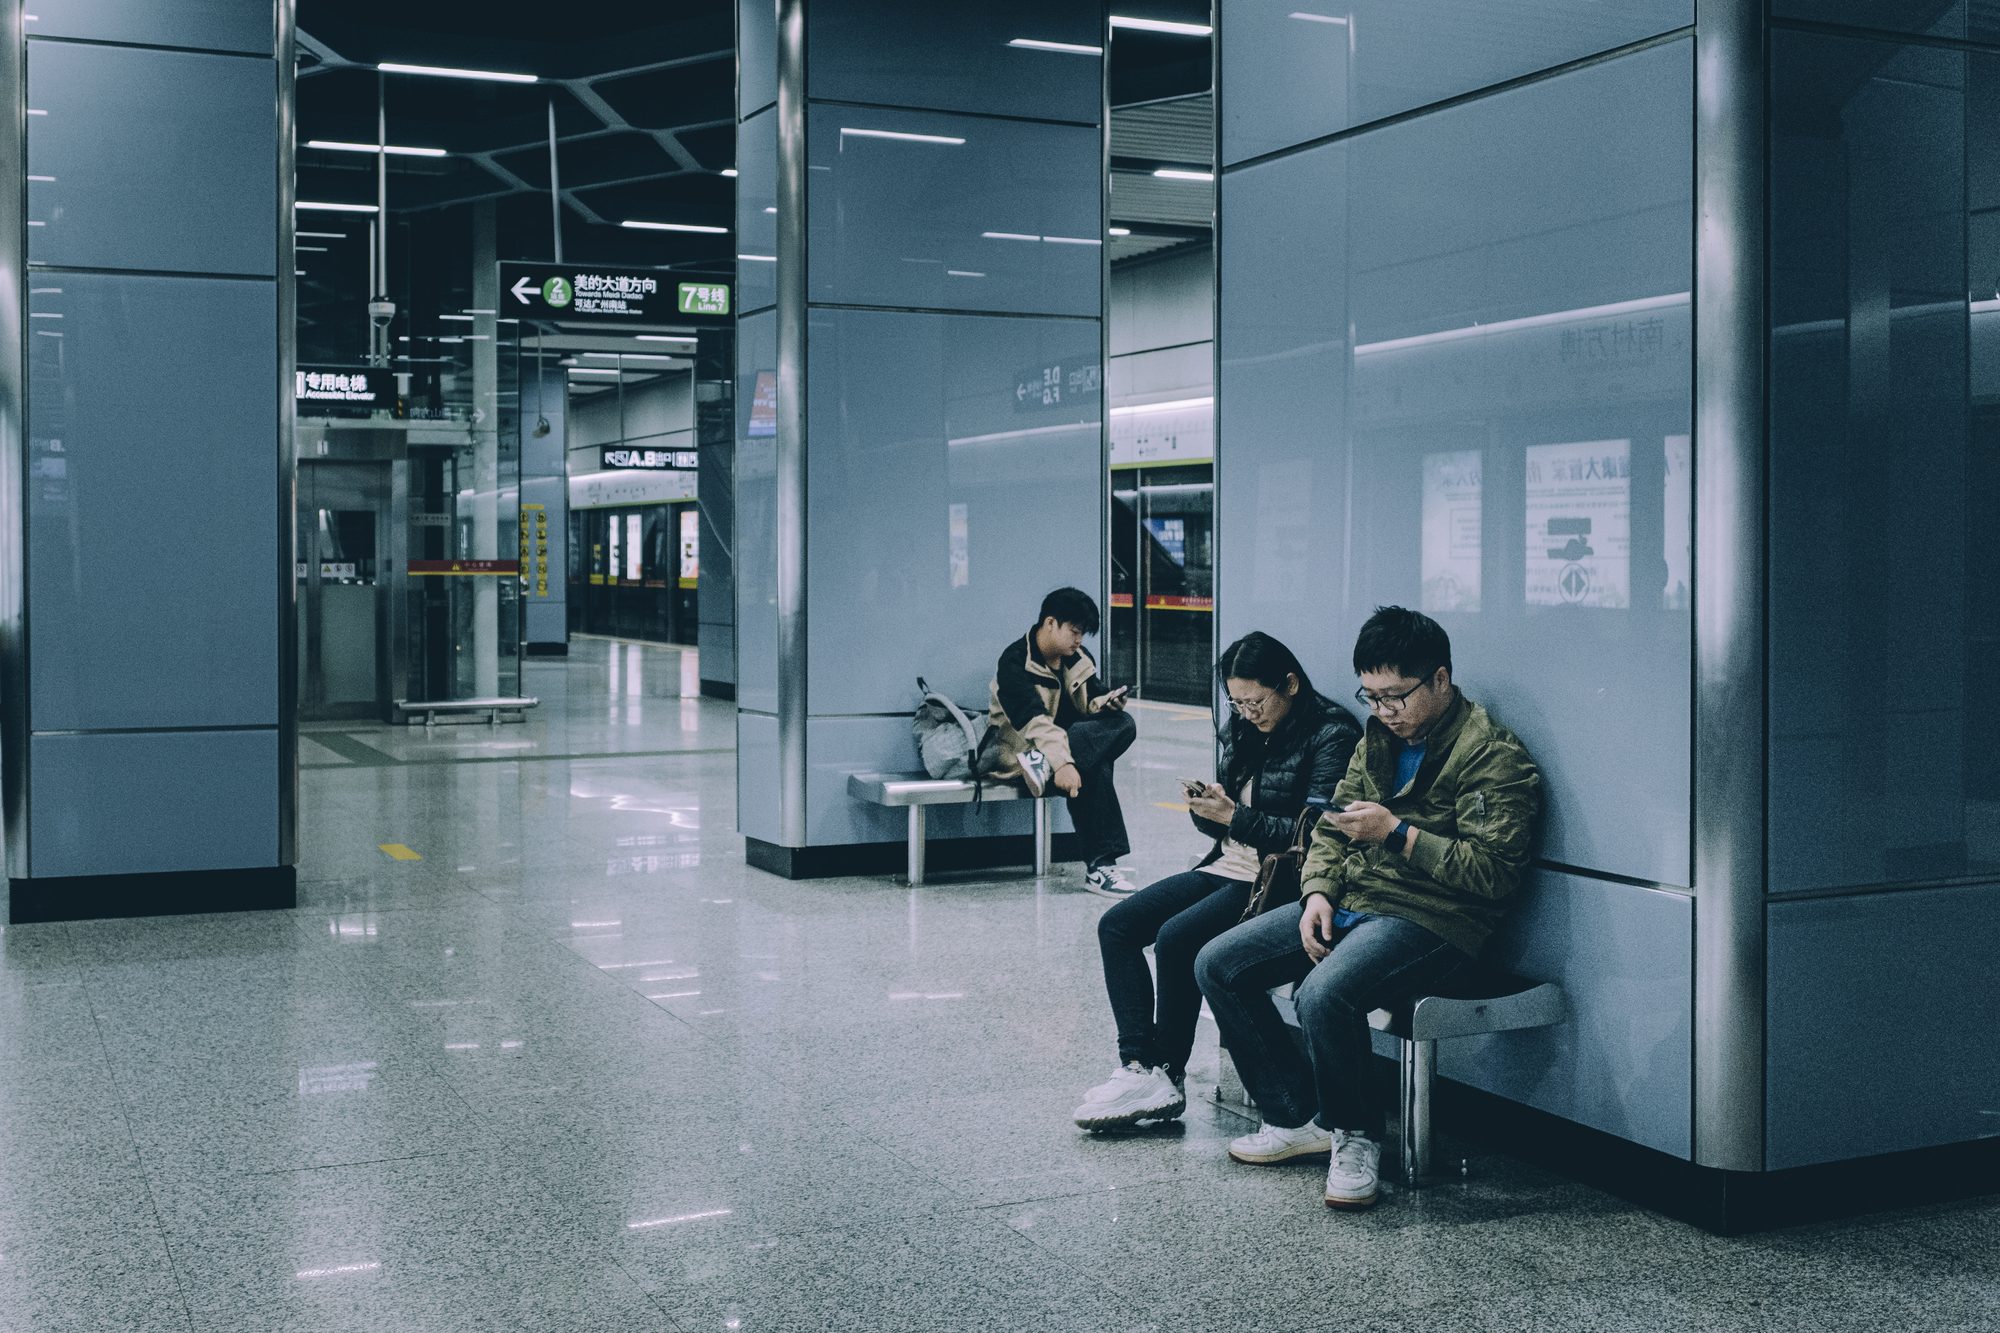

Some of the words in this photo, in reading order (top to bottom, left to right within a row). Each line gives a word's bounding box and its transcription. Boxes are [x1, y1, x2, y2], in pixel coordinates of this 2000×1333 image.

[552, 277, 563, 293] 2
[574, 273, 657, 294] 美的大道方向
[575, 289, 602, 298] Towards
[621, 291, 644, 301] Dadao
[682, 287, 726, 309] 7号线
[574, 298, 627, 310] 可达广州南站
[697, 302, 717, 312] Line
[718, 303, 724, 313] 7
[305, 371, 367, 392] 专用电梯
[305, 389, 345, 400] Accessible
[345, 391, 376, 401] Elevator
[628, 450, 656, 467] A.B
